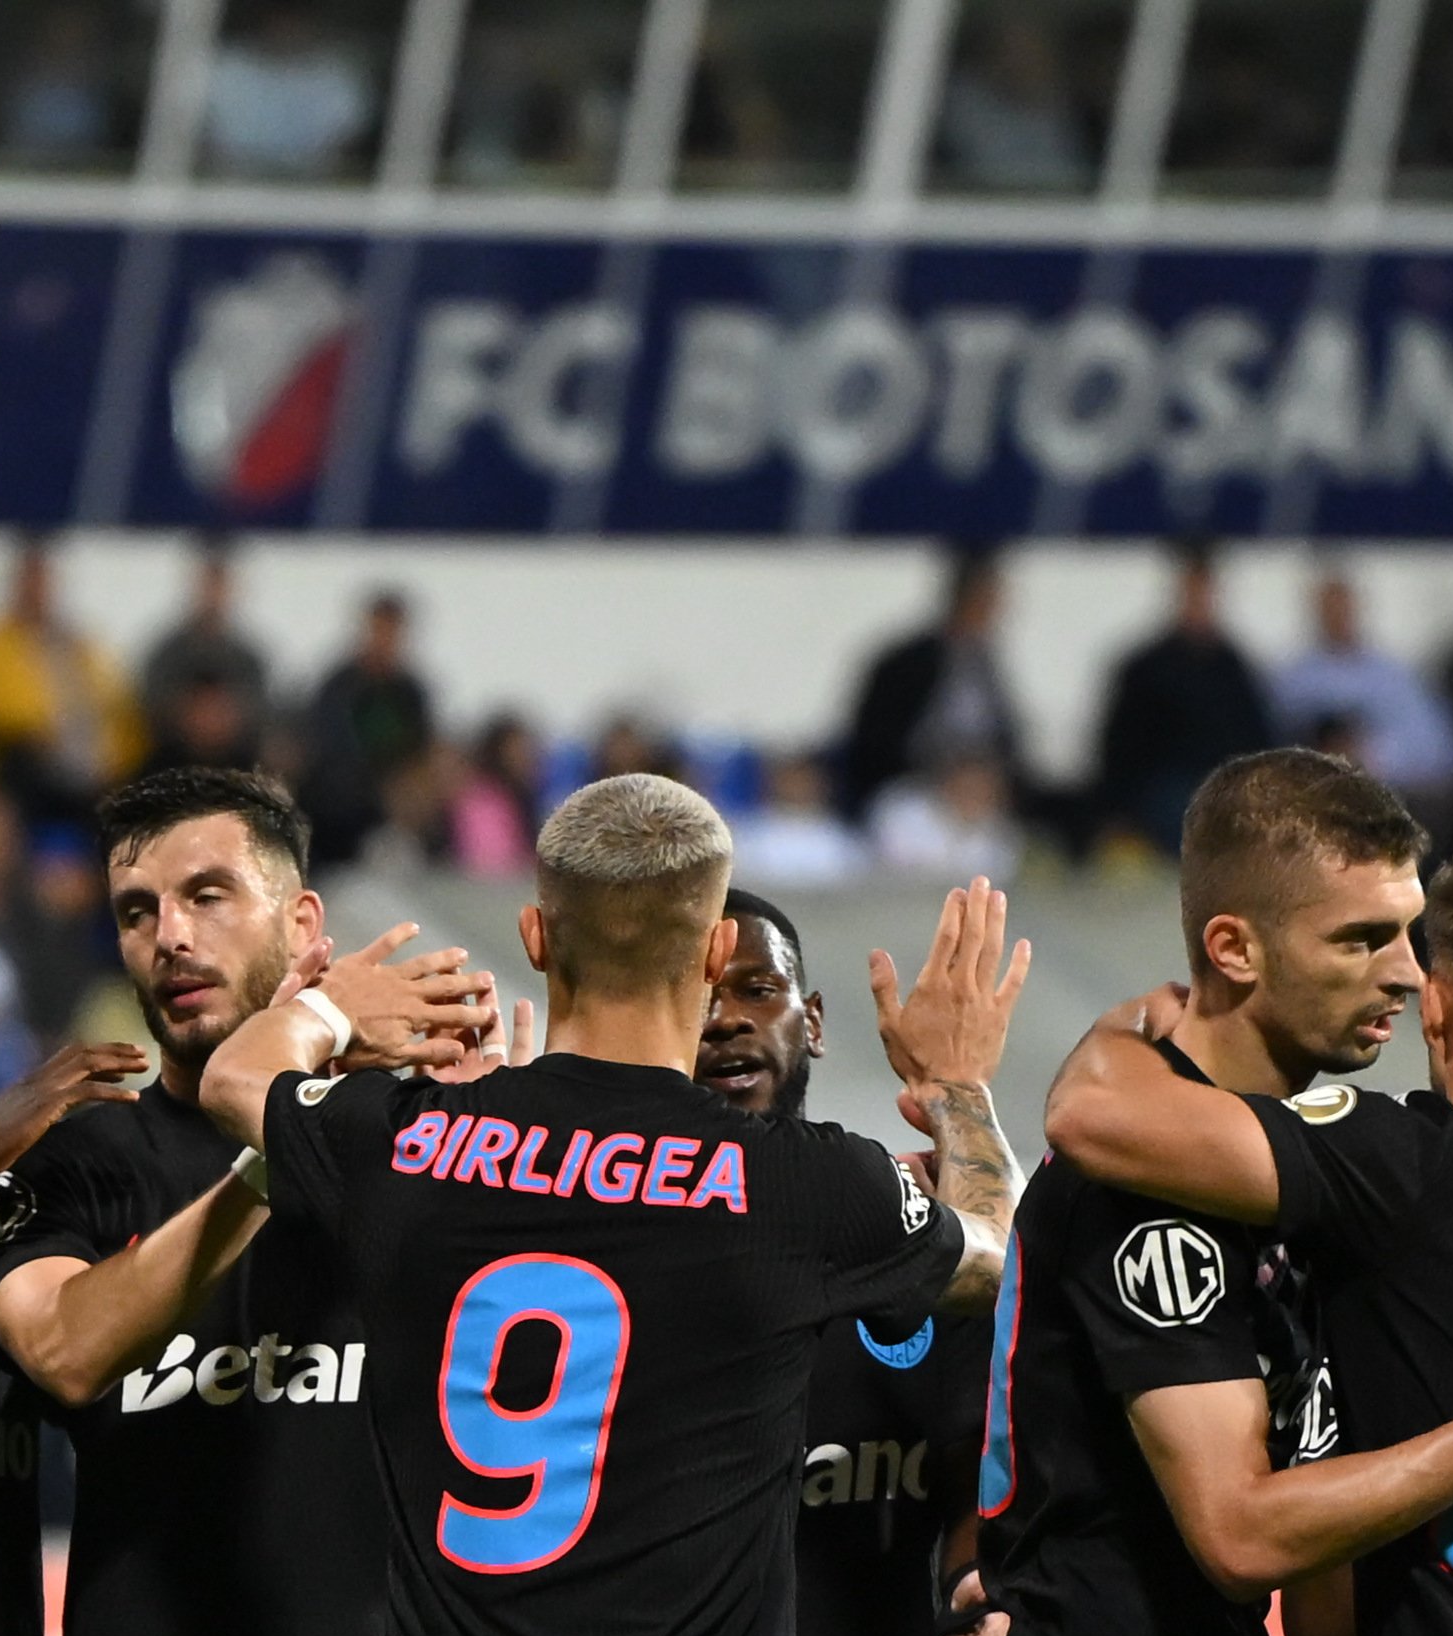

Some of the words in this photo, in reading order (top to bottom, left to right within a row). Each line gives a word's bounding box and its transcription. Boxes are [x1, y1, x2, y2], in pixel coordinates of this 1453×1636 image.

[396, 303, 636, 476] FC
[392, 1111, 748, 1213] BIRLIGEA
[1121, 1226, 1220, 1318] MG
[436, 1252, 631, 1575] 9
